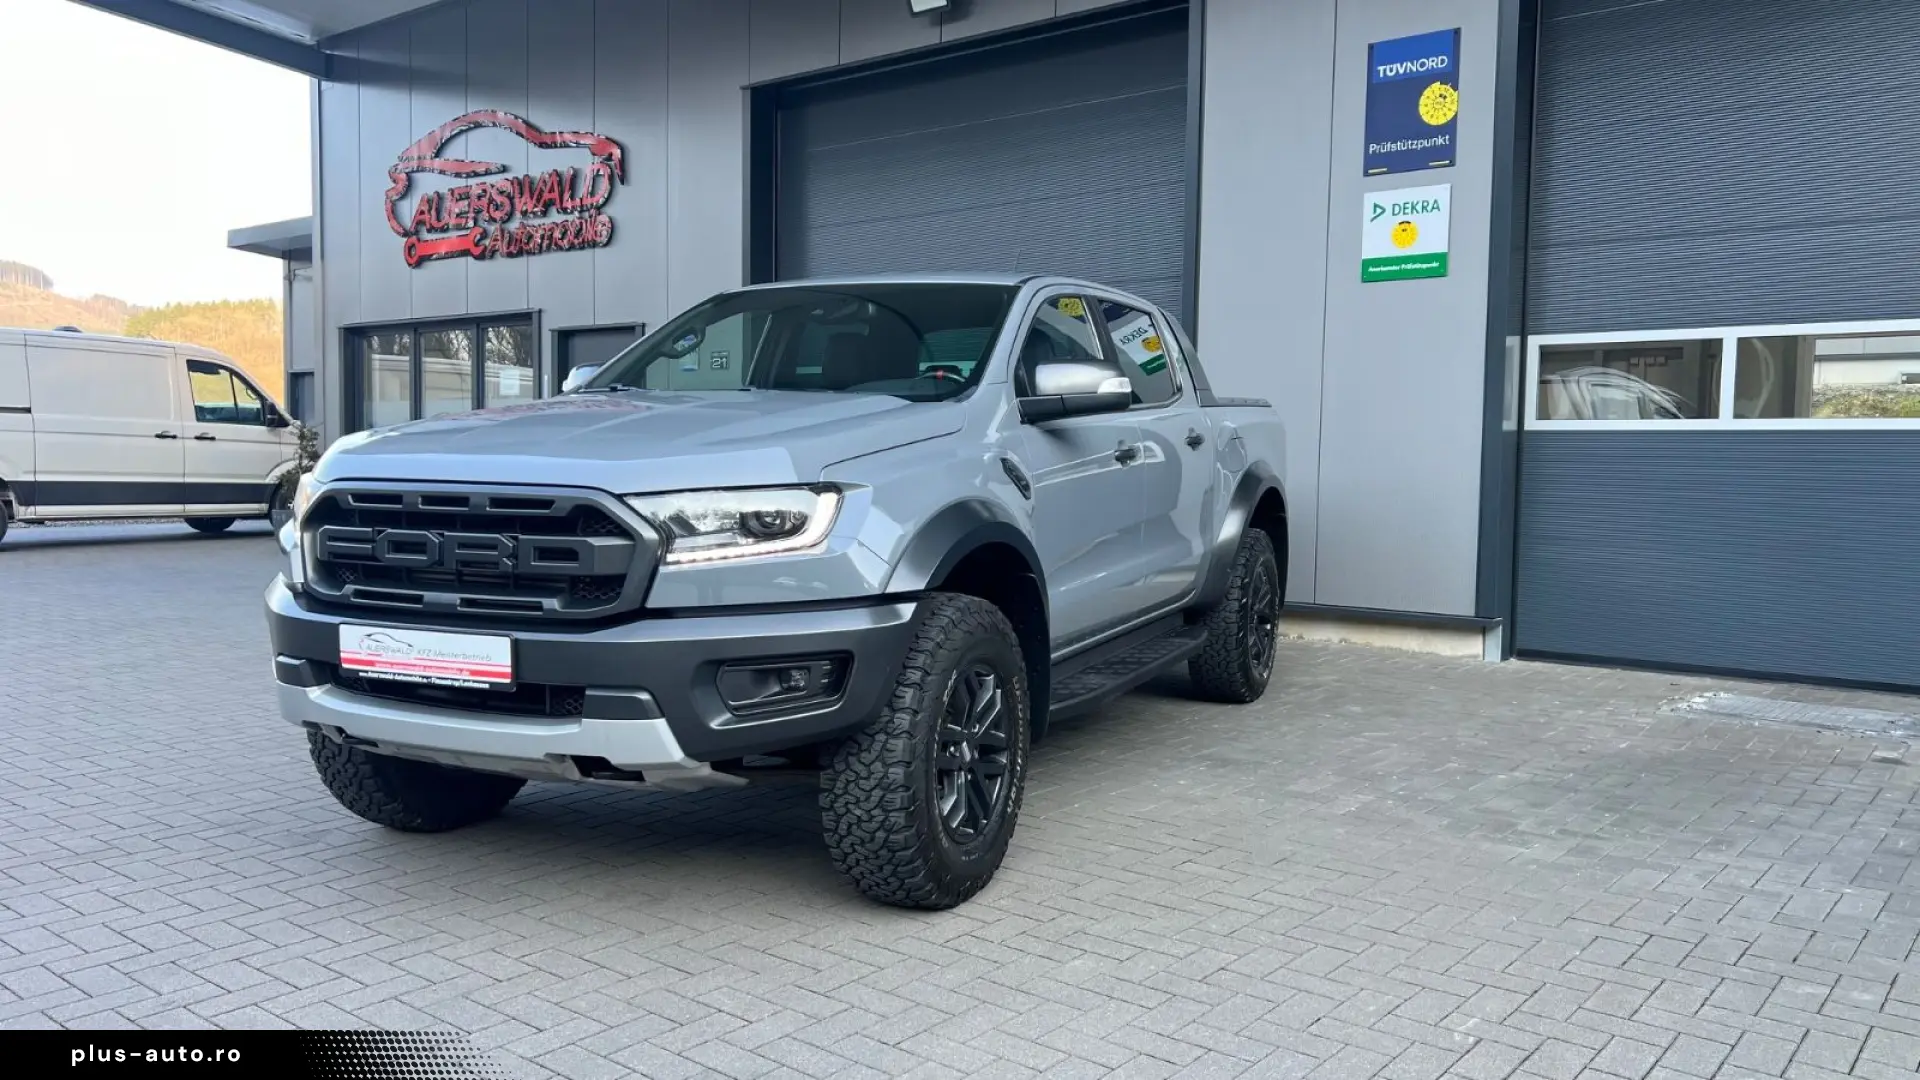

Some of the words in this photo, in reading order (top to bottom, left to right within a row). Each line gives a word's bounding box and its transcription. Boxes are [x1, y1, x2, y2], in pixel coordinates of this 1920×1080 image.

[1368, 134, 1450, 154] Prüfstützpunkt
[409, 161, 612, 234] AUERSWALD
[1391, 199, 1441, 217] DEKRA
[711, 357, 728, 368] 21
[318, 525, 602, 575] FORD
[417, 649, 432, 657] KFZ
